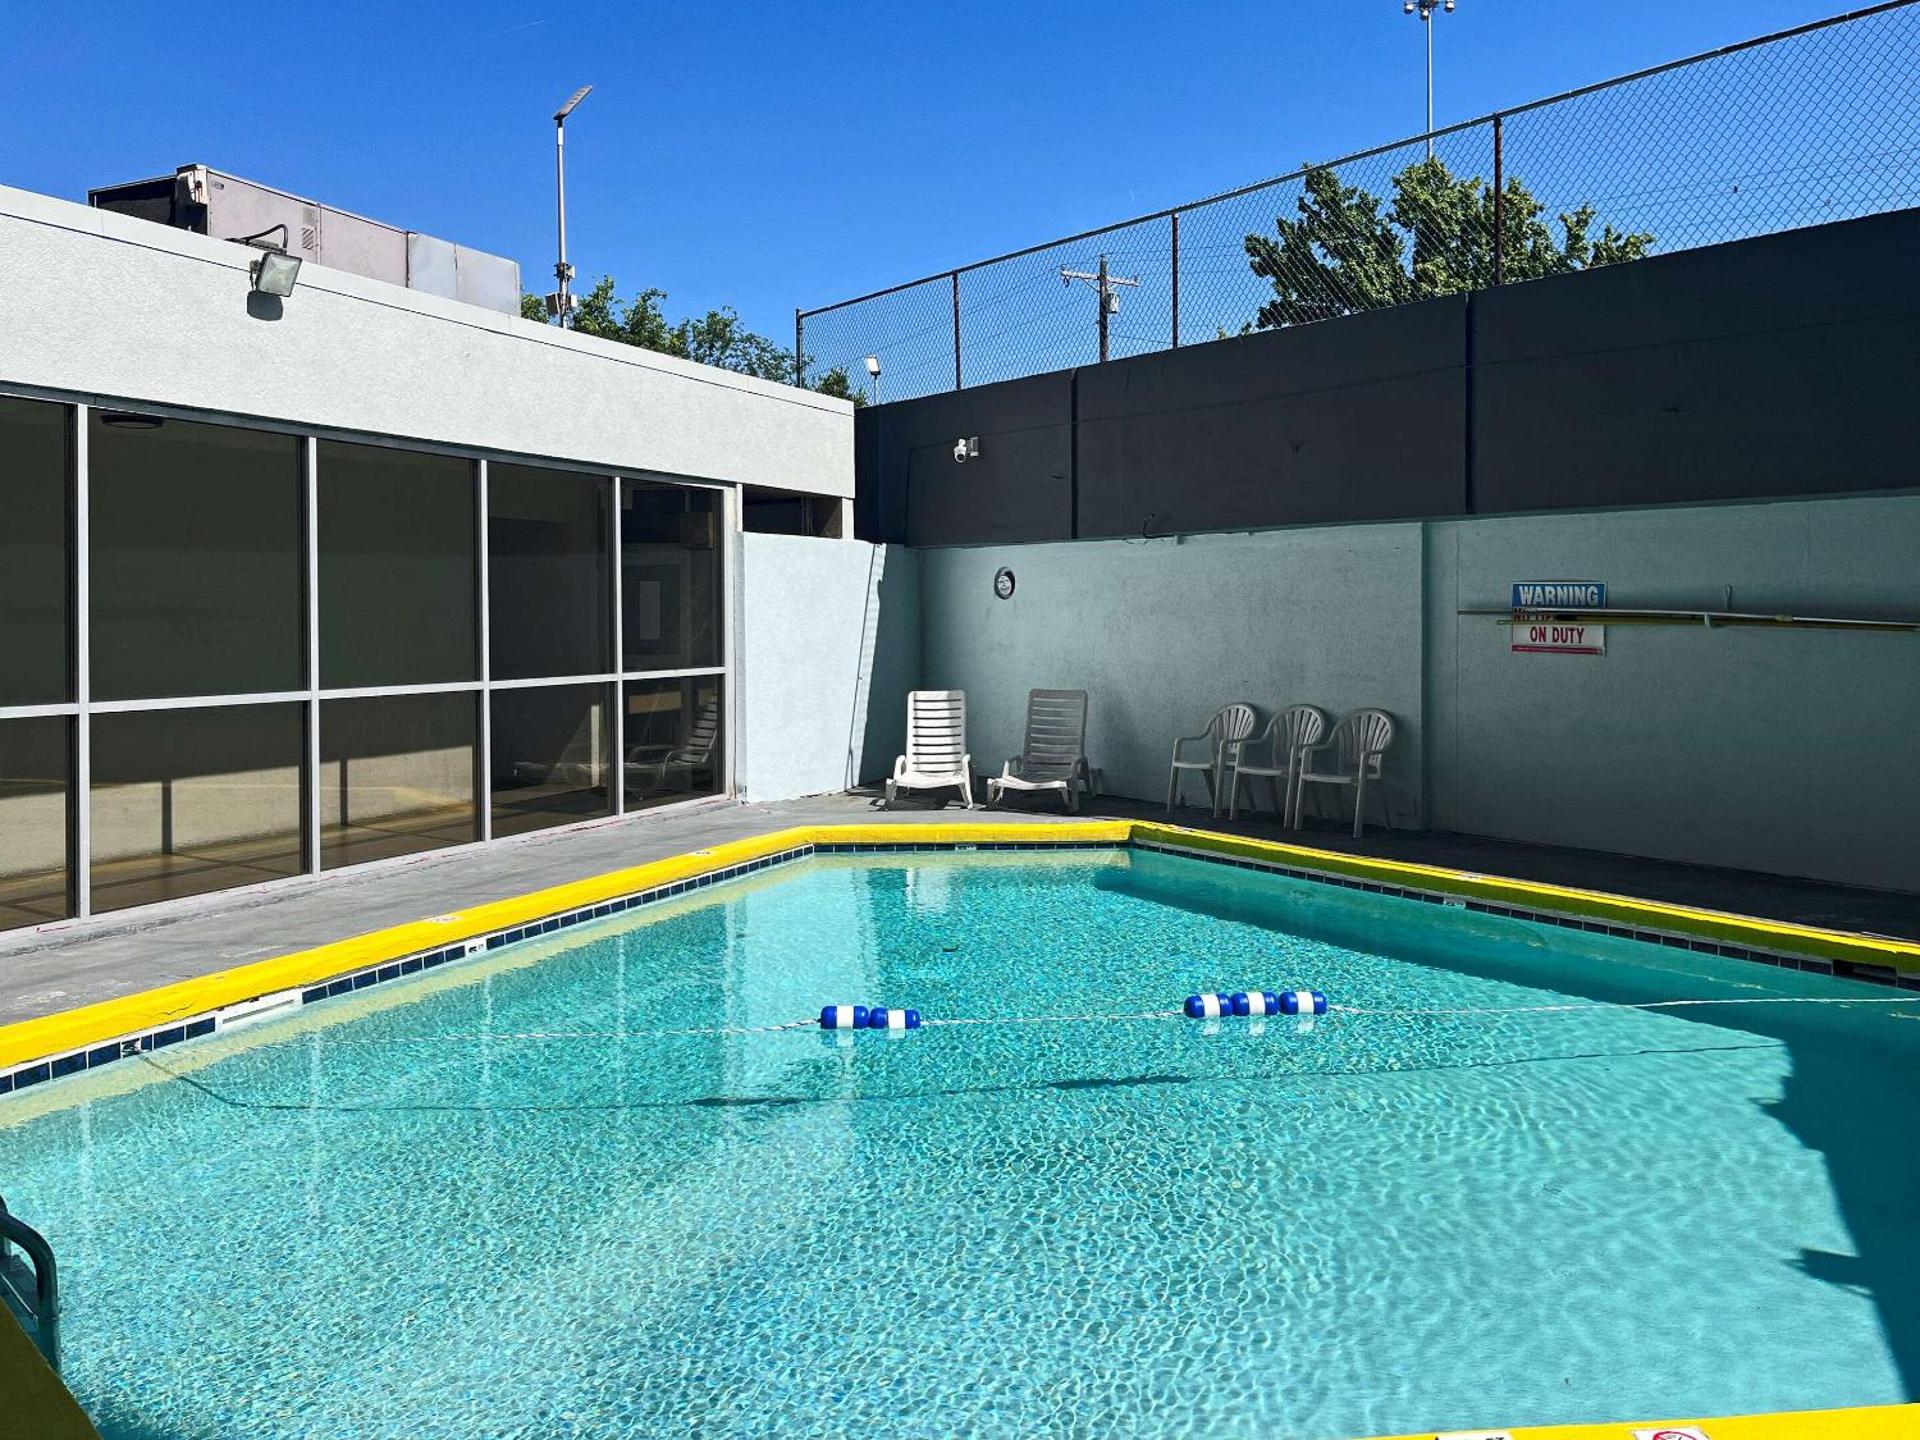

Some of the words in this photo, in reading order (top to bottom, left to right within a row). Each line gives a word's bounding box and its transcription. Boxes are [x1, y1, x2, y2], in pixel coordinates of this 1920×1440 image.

[1519, 585, 1598, 606] WARNING
[1530, 626, 1546, 642] ON
[1552, 626, 1584, 643] DUTY
